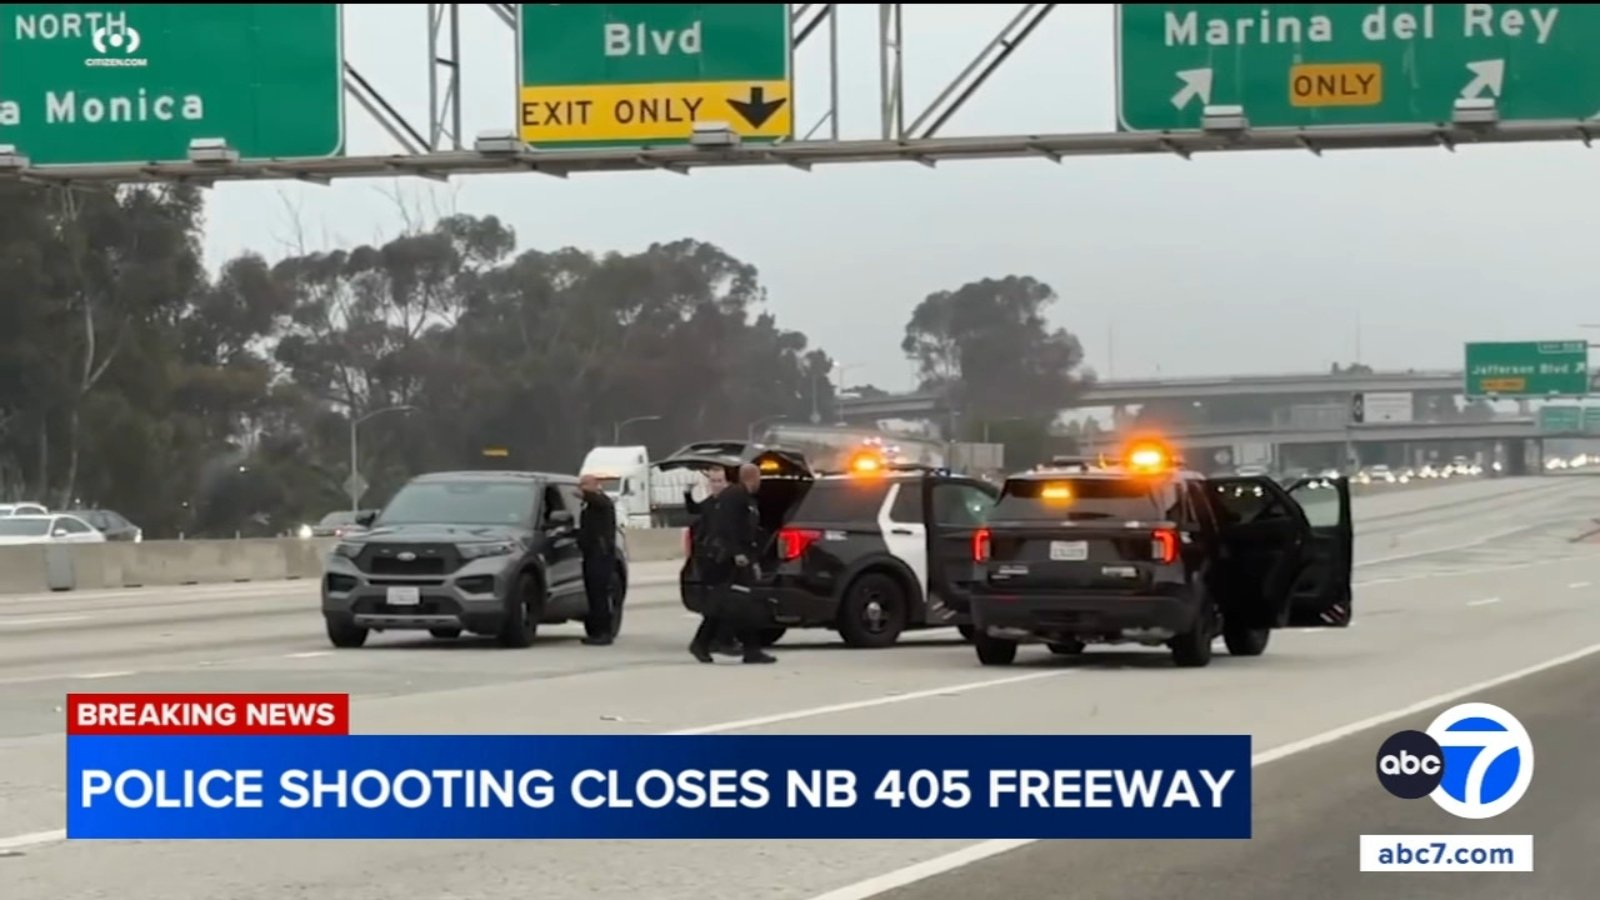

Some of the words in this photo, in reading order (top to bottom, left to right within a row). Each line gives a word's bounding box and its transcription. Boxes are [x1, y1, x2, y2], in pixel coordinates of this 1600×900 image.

[15, 11, 127, 39] NORTH
[604, 20, 702, 56] Blvd
[1164, 10, 1333, 47] Marina
[1362, 4, 1434, 42] del
[1464, 4, 1559, 44] Rey
[1294, 74, 1376, 96] ONLY
[46, 88, 203, 123] Monica
[522, 101, 593, 126] EXIT
[614, 97, 704, 124] ONLY
